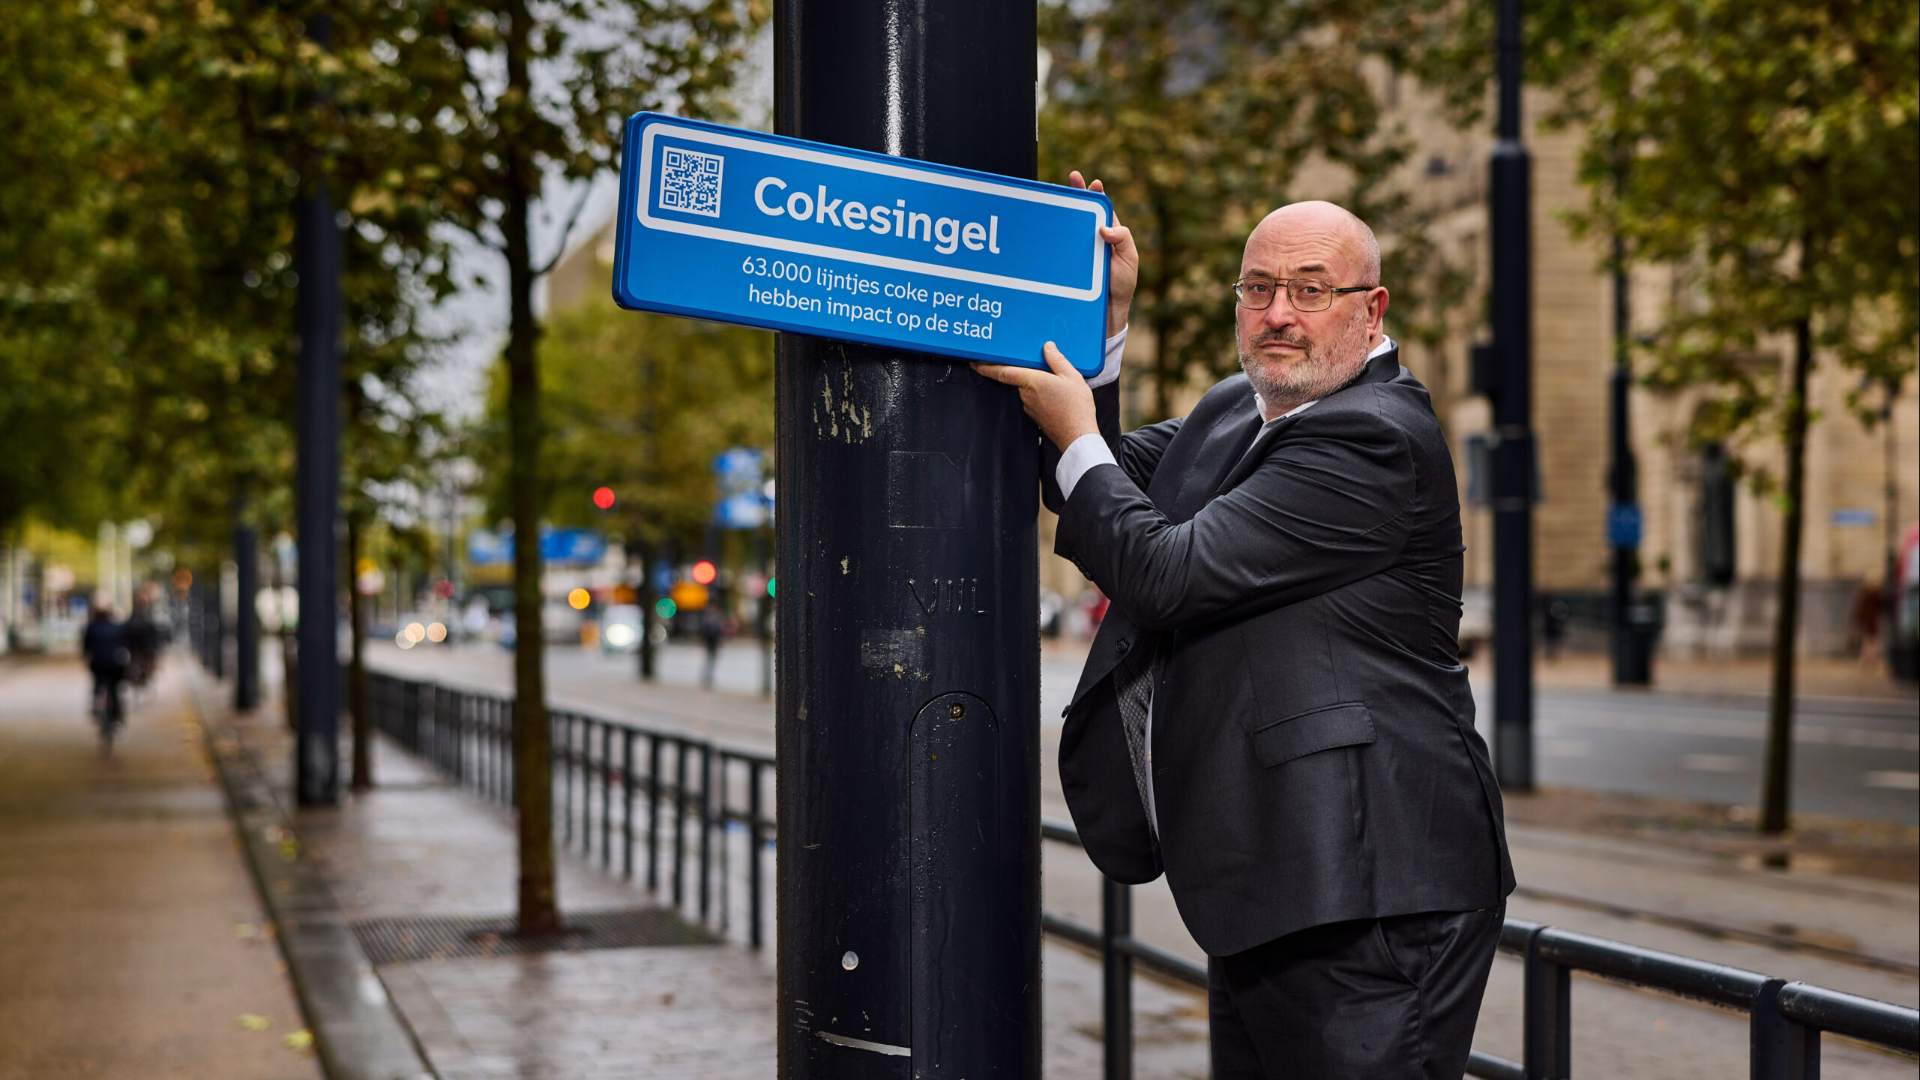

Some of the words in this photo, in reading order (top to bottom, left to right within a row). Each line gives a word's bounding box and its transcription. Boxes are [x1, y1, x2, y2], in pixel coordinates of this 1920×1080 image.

[754, 176, 1000, 255] Cokesingel
[742, 256, 812, 284] 63.000
[816, 267, 880, 297] lijntjes
[884, 282, 929, 303] coke
[932, 291, 965, 308] per
[968, 293, 1003, 319] dag
[749, 283, 822, 313] hebben
[826, 296, 893, 324] impact
[896, 312, 921, 331] op
[925, 313, 949, 333] de
[952, 319, 993, 340] stad
